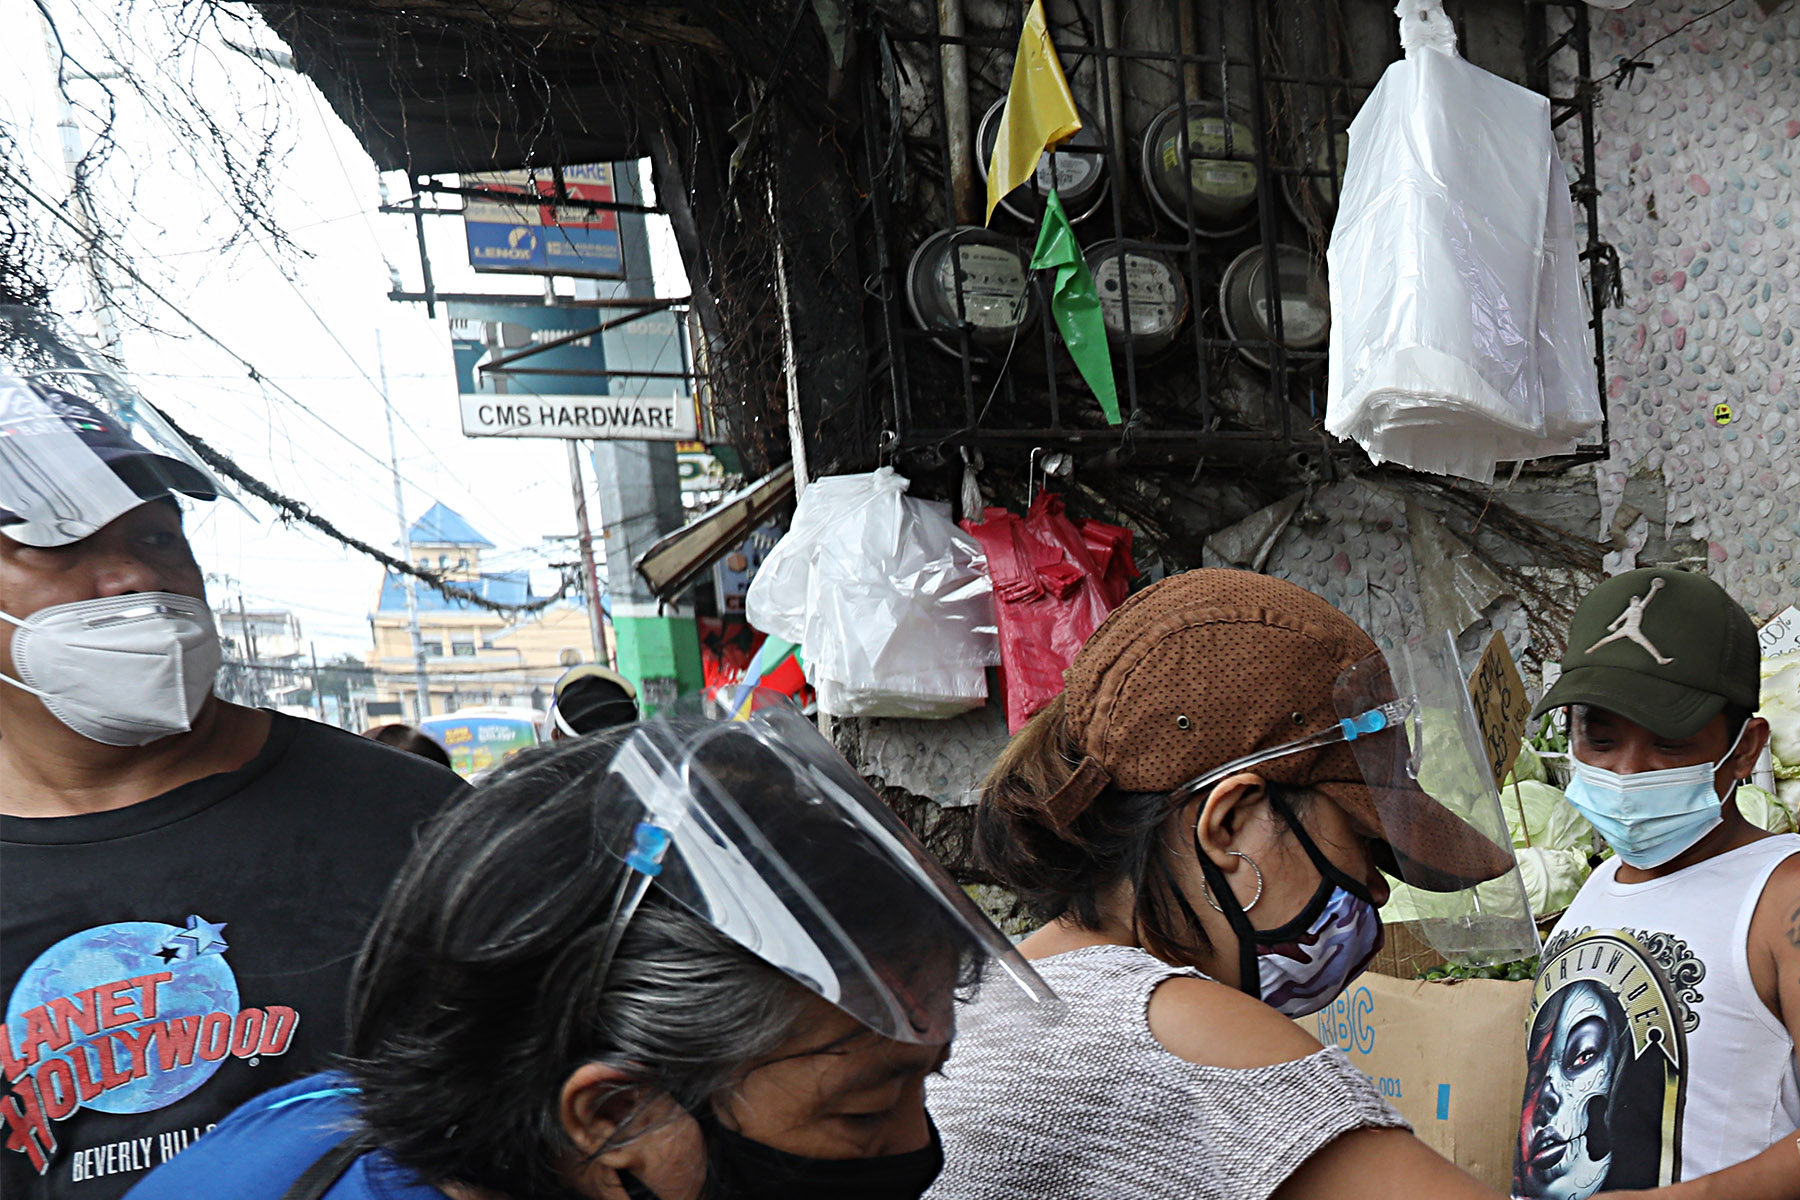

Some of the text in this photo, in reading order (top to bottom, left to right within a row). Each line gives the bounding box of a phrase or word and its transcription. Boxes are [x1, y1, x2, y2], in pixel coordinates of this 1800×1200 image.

[478, 405, 531, 426] CMS
[1529, 944, 1660, 1025] WORLDWIDE
[0, 971, 174, 1084] LANET
[0, 1005, 300, 1176] HOLLYWOOD
[72, 1136, 153, 1182] BEVERLY
